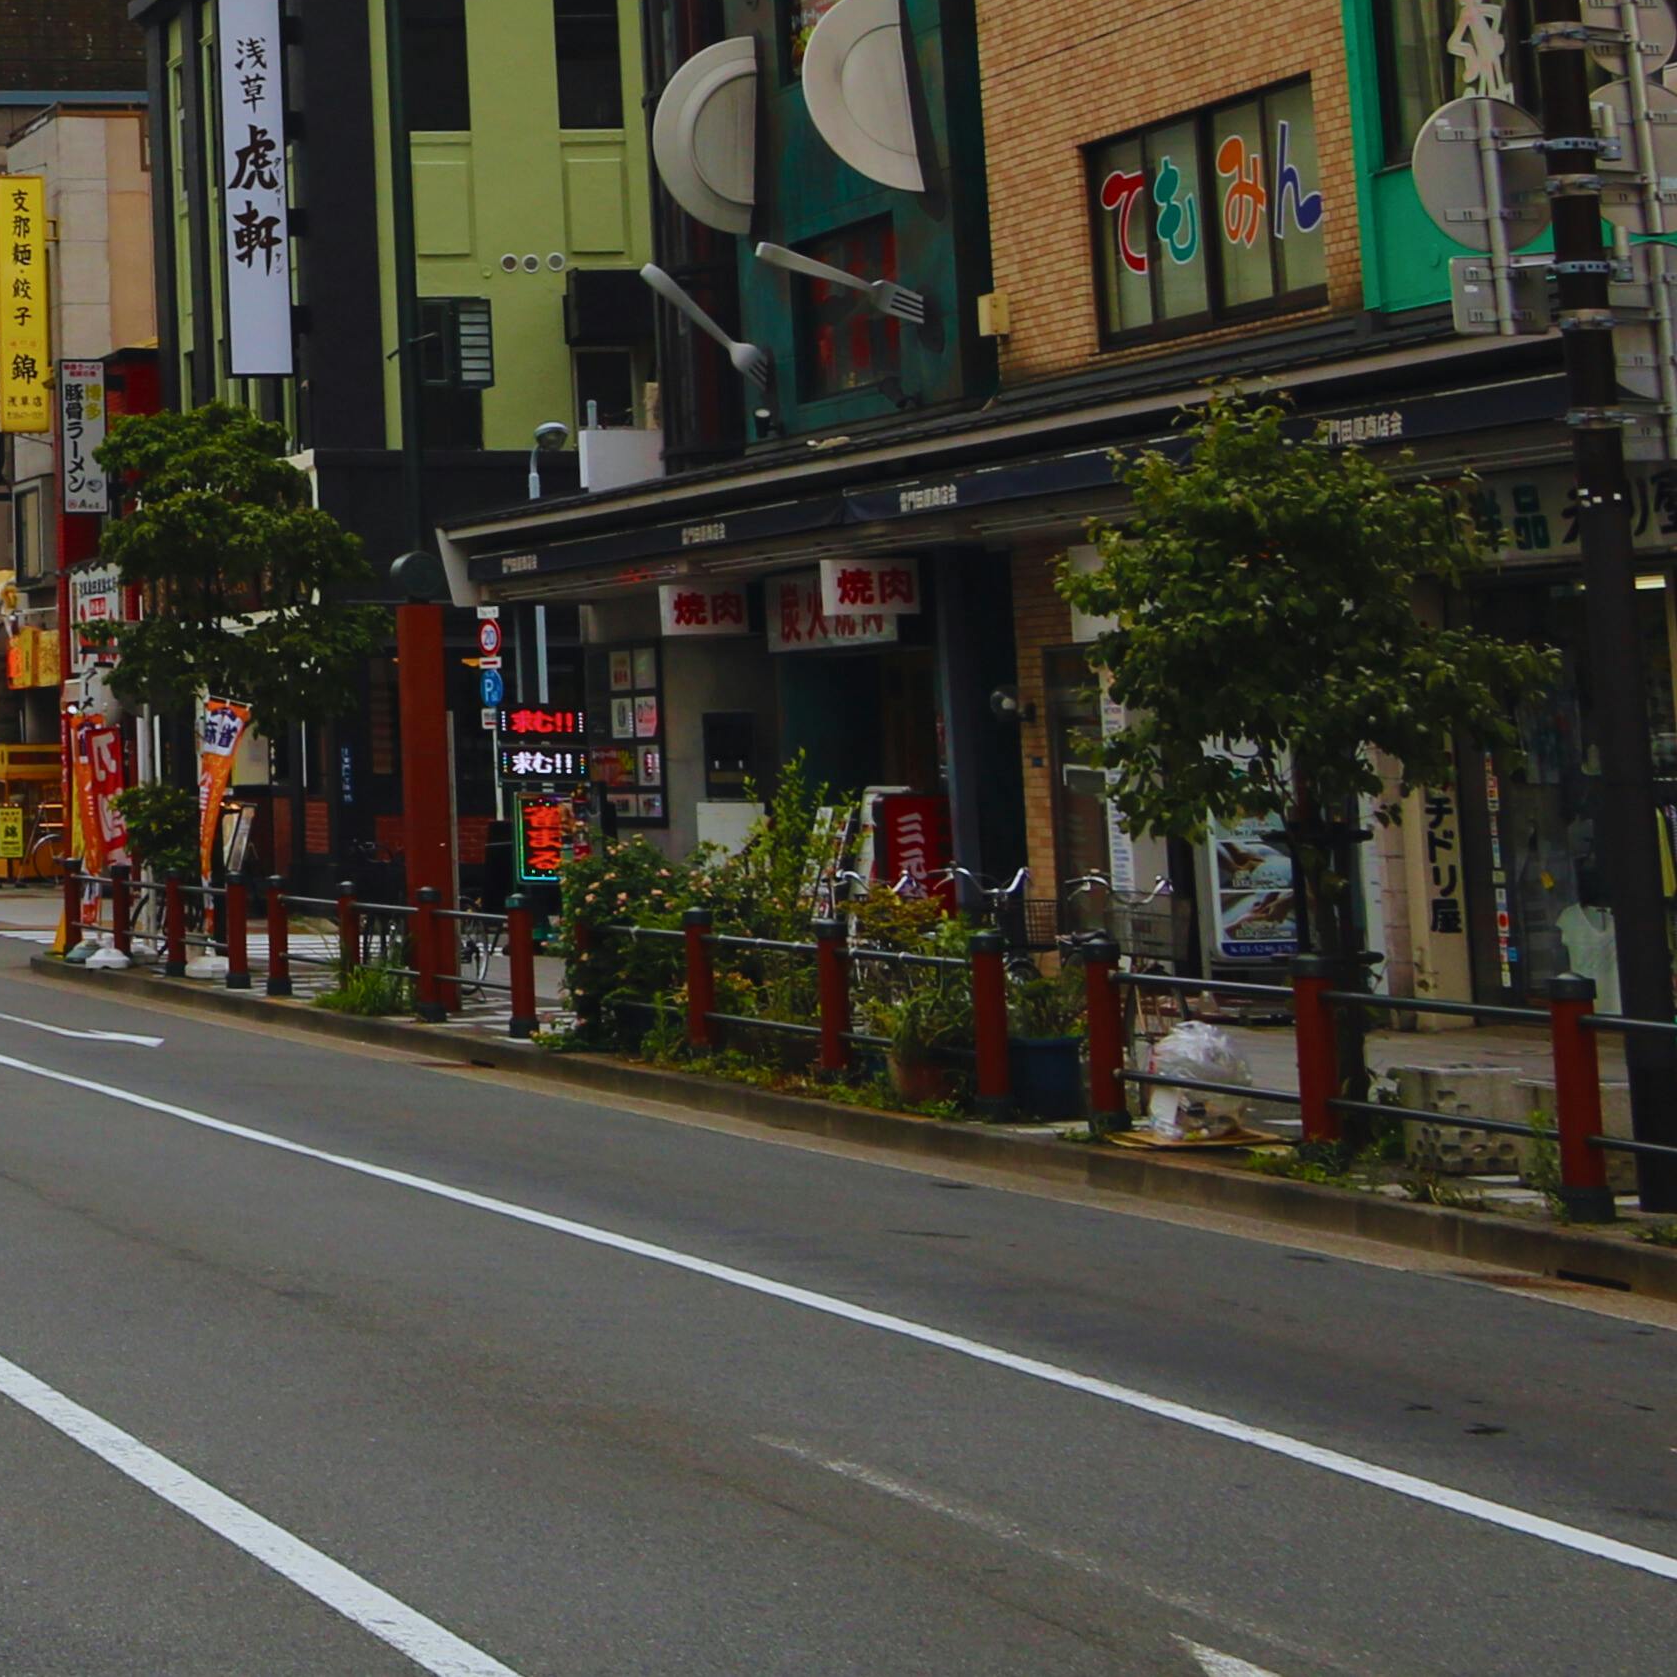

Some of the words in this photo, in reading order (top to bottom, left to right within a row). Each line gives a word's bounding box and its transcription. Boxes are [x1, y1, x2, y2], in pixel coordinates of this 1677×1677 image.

[234, 36, 268, 114] 浅草
[227, 123, 283, 277] 虎軒
[1100, 120, 1323, 275] てもみん
[11, 353, 39, 385] 錦
[64, 383, 86, 494] 豚骨ラーメン
[837, 567, 916, 607] 焼肉
[674, 591, 744, 627] 焼肉
[483, 629, 495, 646] 20
[510, 709, 575, 734] 求む!!
[511, 751, 573, 775] 求む!!
[1425, 796, 1463, 934] チドリ屋
